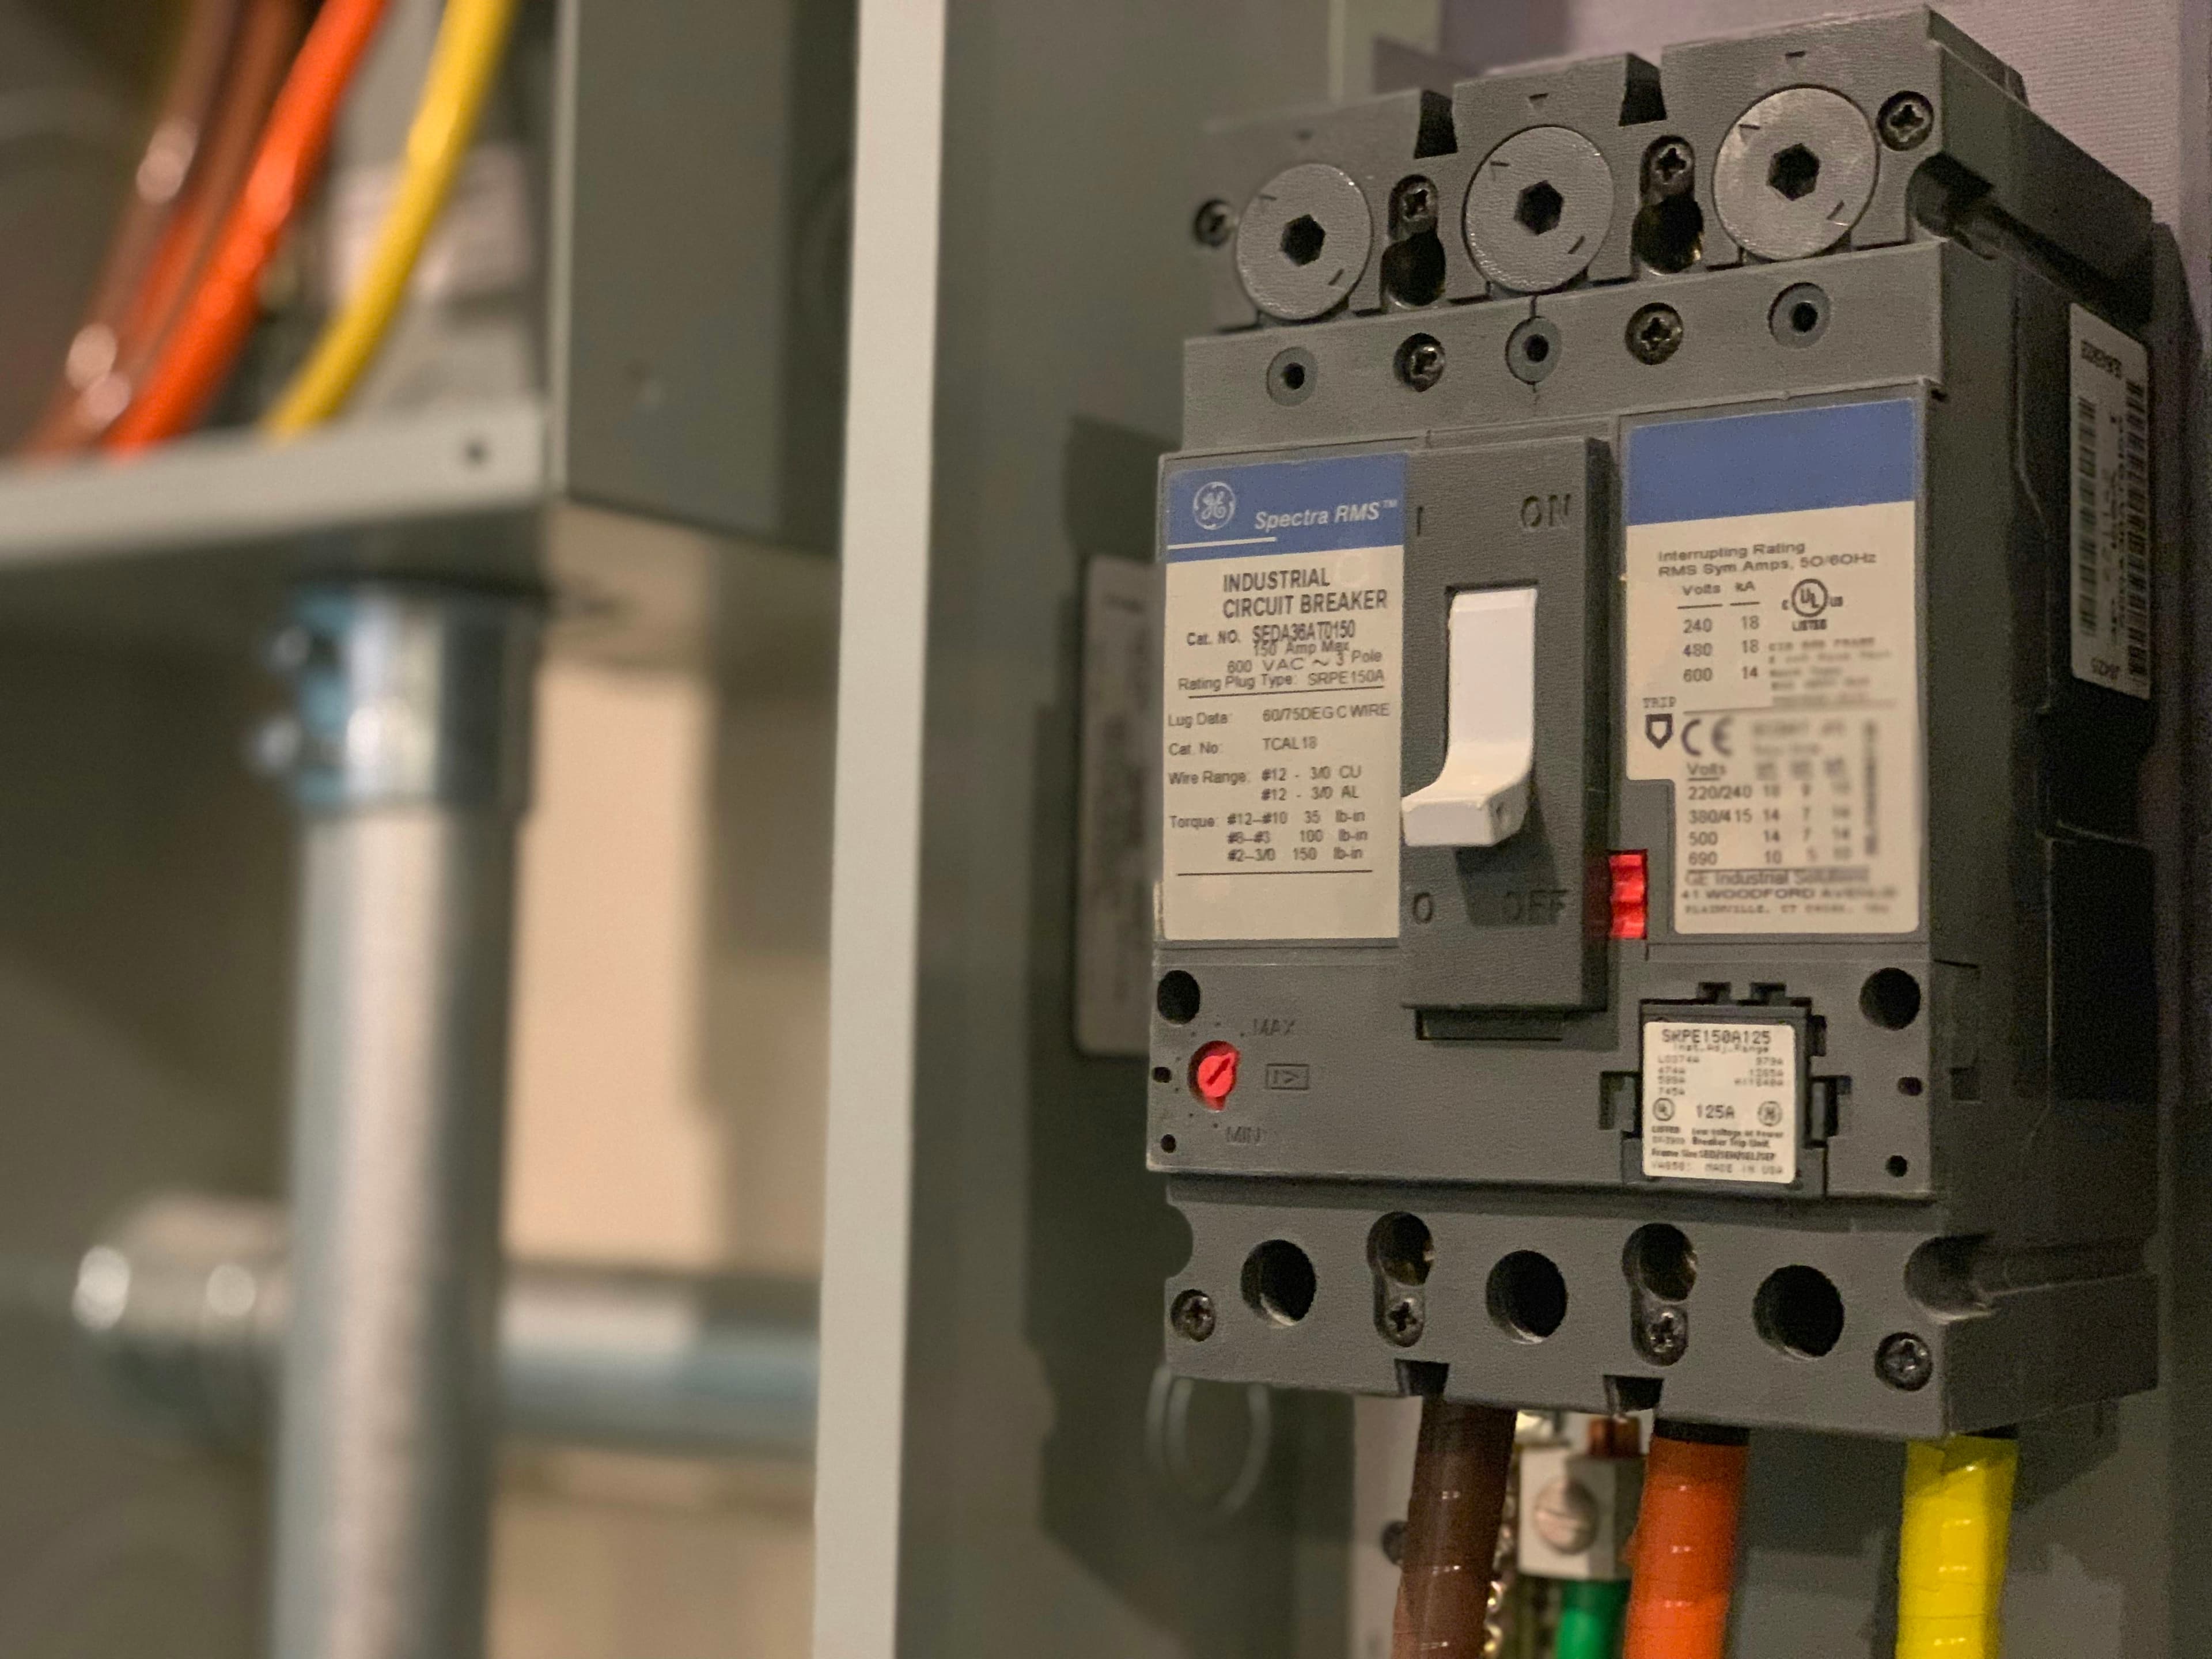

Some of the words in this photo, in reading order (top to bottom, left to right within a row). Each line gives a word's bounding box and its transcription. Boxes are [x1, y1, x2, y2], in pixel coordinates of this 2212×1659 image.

[1255, 509, 1329, 533] Spectra
[1658, 547, 1748, 563] Interrupting
[1753, 543, 1806, 556] Rating
[1658, 565, 1697, 577] RMS
[1703, 563, 1737, 577] Sym
[1223, 567, 1330, 593] INDUSTRIAL
[1683, 584, 1721, 597] Volts
[1223, 595, 1294, 618] CIRCUIT
[1300, 589, 1388, 614] BREAKER
[1683, 618, 1713, 634] 240
[1741, 615, 1760, 630] 18
[1187, 632, 1211, 646] Cat.
[1253, 642, 1277, 657] 150
[1286, 641, 1316, 655] Amp
[1321, 640, 1349, 652] Max
[1683, 642, 1713, 657] 480
[1741, 639, 1760, 653] 18
[1227, 660, 1253, 674] 600
[1263, 657, 1305, 671] VAC
[1336, 652, 1344, 666] 3
[1351, 649, 1382, 664] Pole
[1178, 677, 1222, 691] Rating
[1225, 674, 1255, 690] Plug
[1683, 668, 1713, 683] 600
[1741, 666, 1759, 679] 14
[1168, 712, 1195, 728] Lug
[1349, 703, 1390, 718] WIRE
[1168, 771, 1199, 785] Wire
[1262, 767, 1287, 781] #12
[1339, 764, 1362, 779] CU
[1261, 787, 1287, 801] #12
[1341, 785, 1359, 798] AL
[1688, 785, 1752, 801] 220/240
[1304, 810, 1320, 824] 35
[1763, 808, 1781, 821] 14
[1300, 829, 1323, 842] 100
[1688, 831, 1718, 846] 500
[1763, 830, 1781, 843] 14
[1292, 847, 1318, 861] 150
[1688, 851, 1718, 865] 690
[1764, 850, 1782, 864] 10
[1706, 888, 1815, 900] WOODFORD
[1696, 1104, 1735, 1119] 125A
